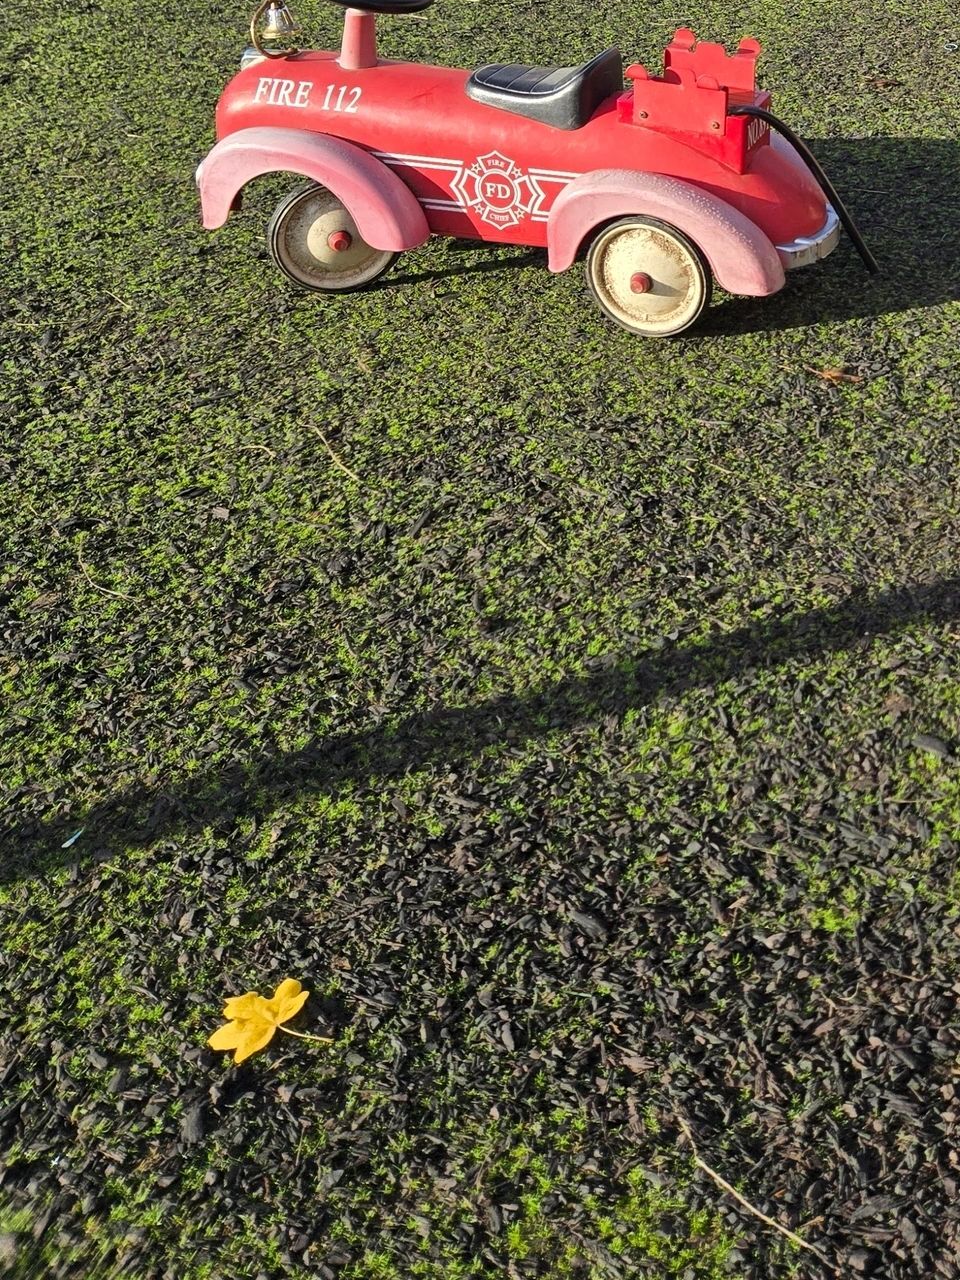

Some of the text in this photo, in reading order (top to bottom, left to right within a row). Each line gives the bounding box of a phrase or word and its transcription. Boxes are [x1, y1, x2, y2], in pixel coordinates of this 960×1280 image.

[252, 77, 362, 113] FIRE 112
[487, 159, 505, 168] FIRE
[485, 182, 510, 199] FD
[489, 213, 509, 222] CHIEF
